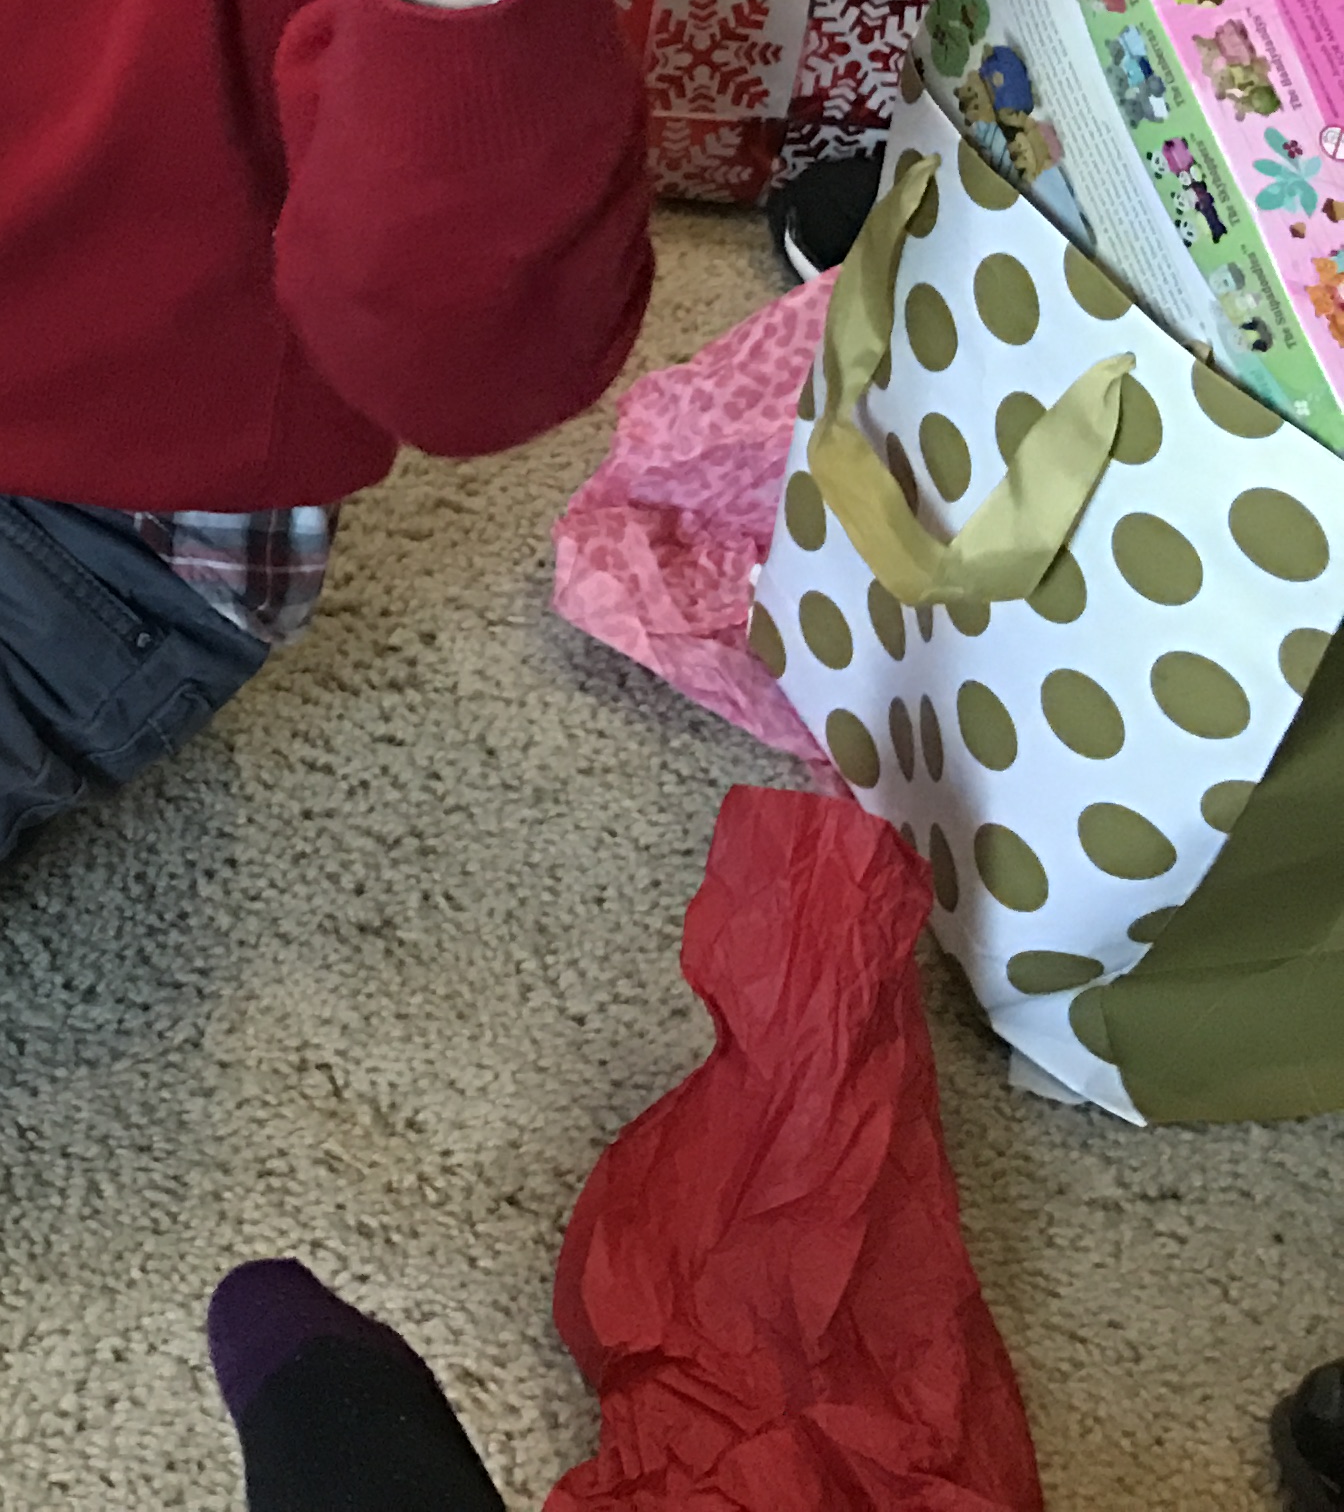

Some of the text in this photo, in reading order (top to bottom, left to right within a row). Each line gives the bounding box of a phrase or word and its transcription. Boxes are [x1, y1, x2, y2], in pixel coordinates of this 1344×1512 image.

[1288, 90, 1302, 110] The
[1226, 205, 1240, 227] The
[1282, 327, 1297, 350] The
